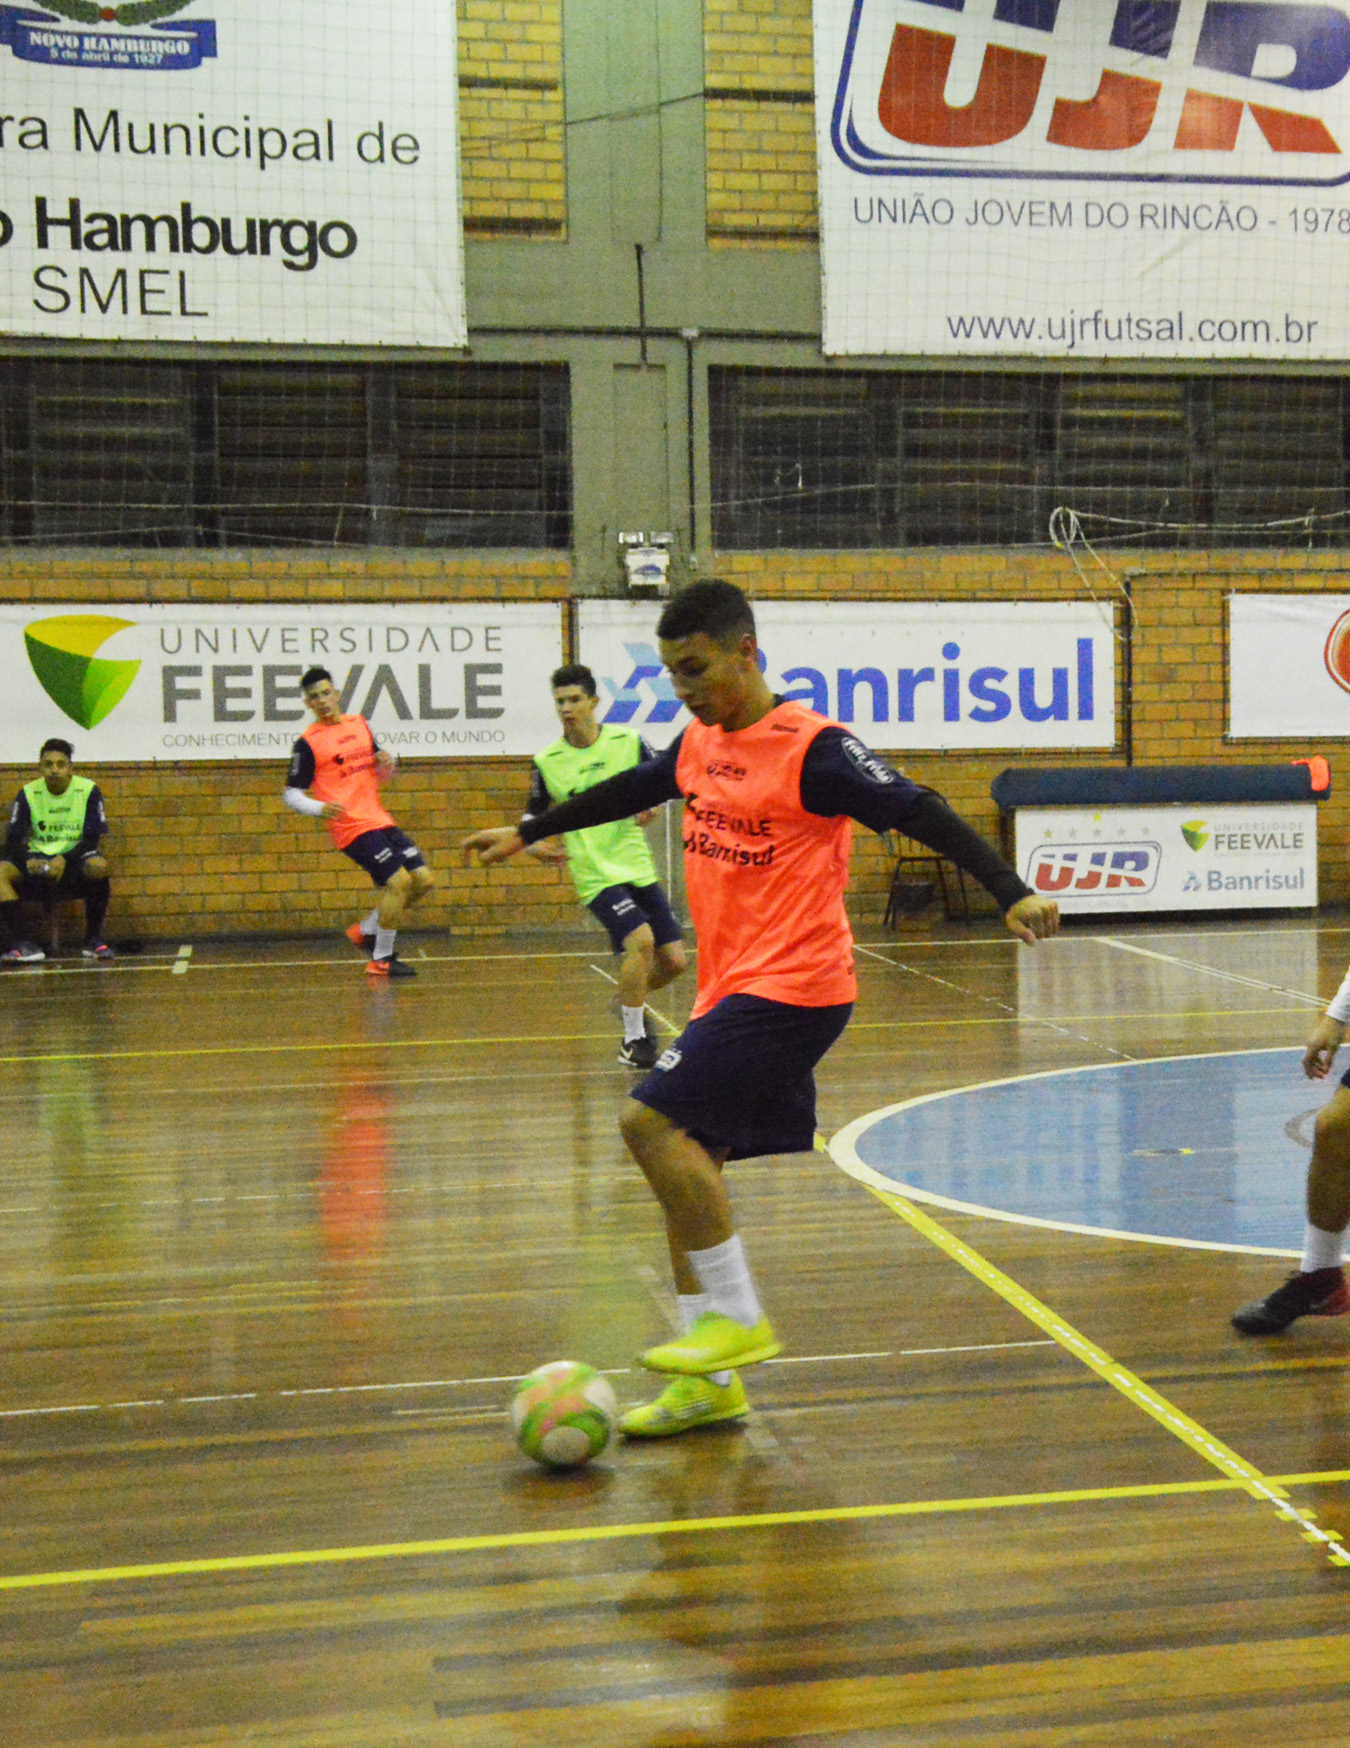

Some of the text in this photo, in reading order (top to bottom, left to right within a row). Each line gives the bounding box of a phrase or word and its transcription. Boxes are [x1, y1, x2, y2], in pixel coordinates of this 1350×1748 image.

[29, 31, 191, 56] NOVO HAMBURGO
[61, 50, 78, 60] de
[81, 50, 110, 63] abril
[113, 52, 130, 64] de
[73, 106, 334, 171] Municipal
[356, 121, 421, 166] de
[853, 192, 954, 226] UNIÃO
[965, 199, 1073, 229] JOVEM
[1085, 202, 1129, 229] DO
[35, 195, 358, 271] Hamburgo
[33, 265, 210, 317] SMEL
[947, 309, 1319, 349] www.ujrfutsal.com.br
[160, 626, 503, 654] UNIVERSIDADE
[757, 638, 1094, 723] anrisul
[373, 731, 421, 746] OVAR
[425, 730, 438, 744] O
[442, 730, 506, 745] MUNDO
[1214, 832, 1304, 851] FEEVALE
[1035, 850, 1150, 892] UJR
[1207, 867, 1305, 891] Banrisul
